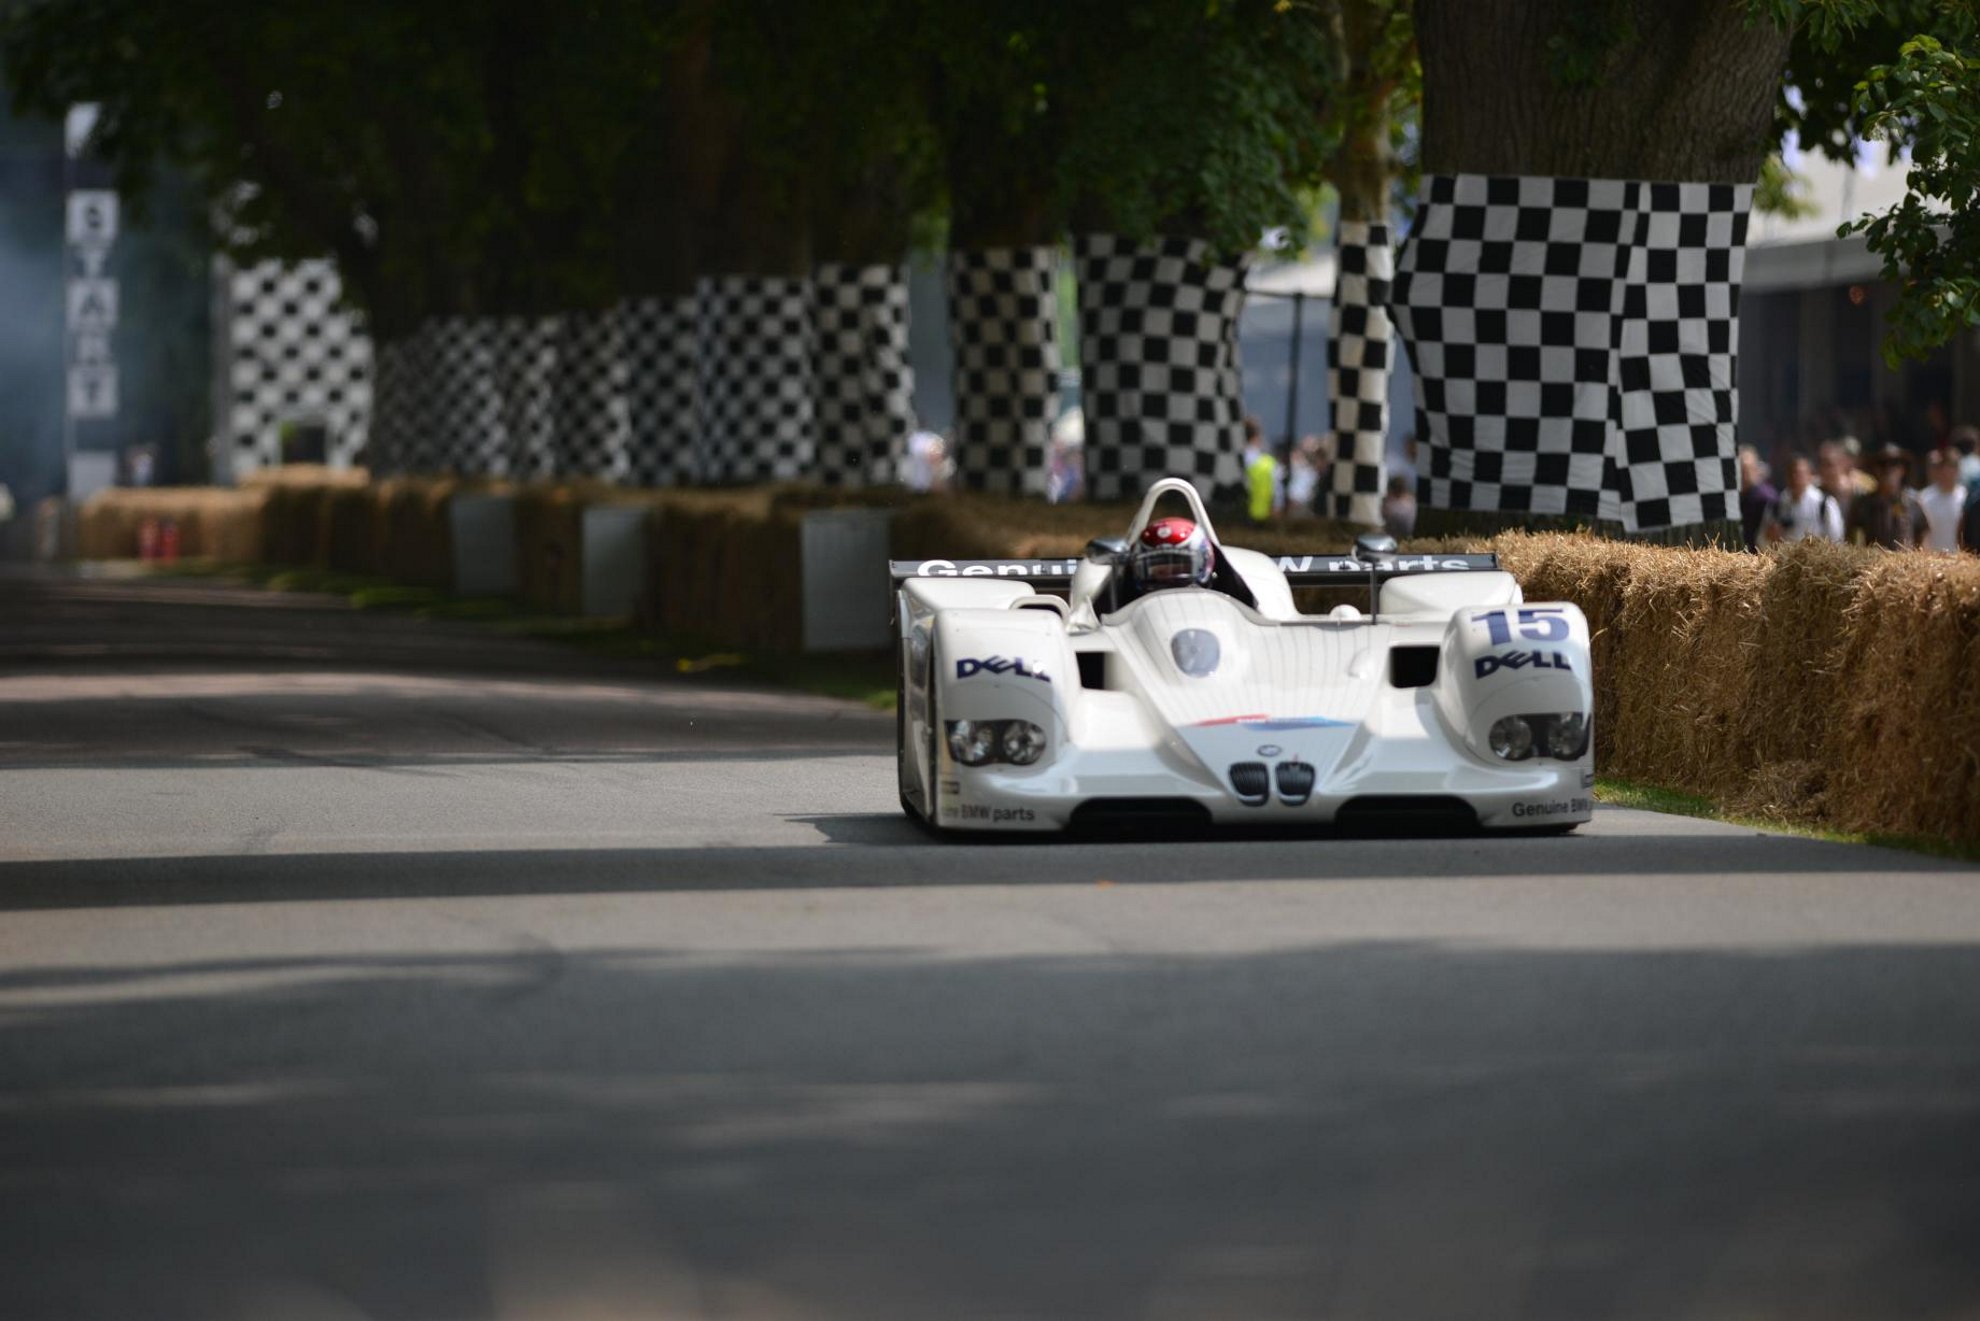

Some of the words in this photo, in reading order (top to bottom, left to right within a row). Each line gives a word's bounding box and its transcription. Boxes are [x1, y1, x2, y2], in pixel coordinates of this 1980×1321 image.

[917, 559, 1079, 577] Genui
[1471, 608, 1570, 646] 15
[956, 655, 1051, 682] DELL
[1474, 650, 1572, 679] DELL
[993, 806, 1035, 822] parts
[1512, 800, 1569, 817] Genuine
